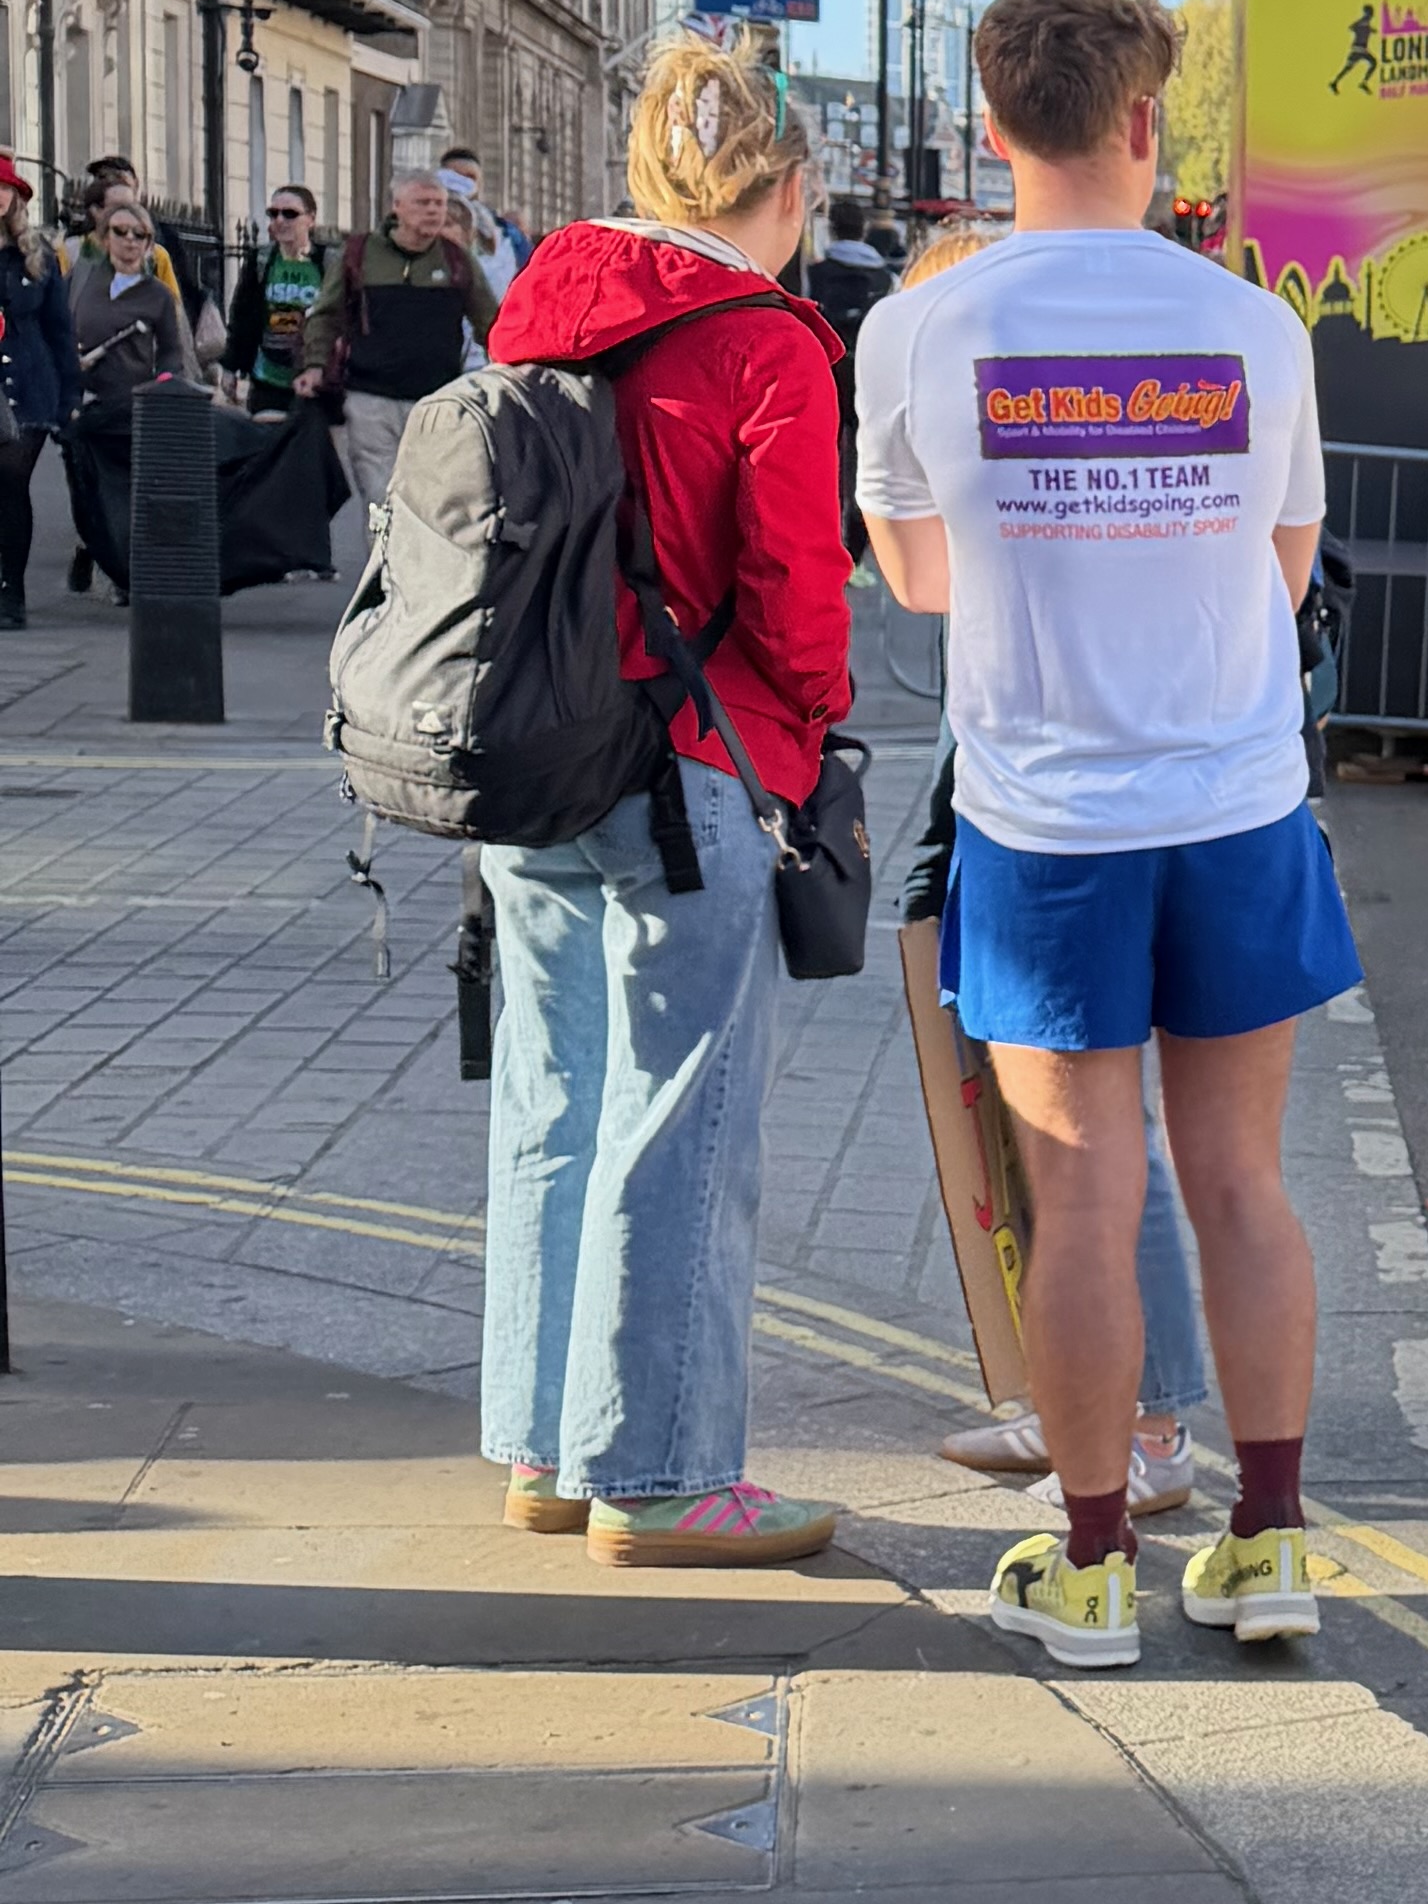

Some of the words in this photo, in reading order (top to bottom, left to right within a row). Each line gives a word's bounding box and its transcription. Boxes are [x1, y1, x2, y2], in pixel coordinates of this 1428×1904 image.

[987, 388, 1047, 424] Get
[1049, 386, 1122, 423] Kids
[1127, 378, 1242, 430] Going!
[1028, 469, 1078, 492] THE
[1145, 465, 1211, 489] TEAM
[996, 493, 1240, 520] www.getkidsgoing.com
[1000, 521, 1103, 540] SUPPORTING
[1106, 520, 1189, 540] DISABILITY
[1193, 516, 1239, 536] SPORT
